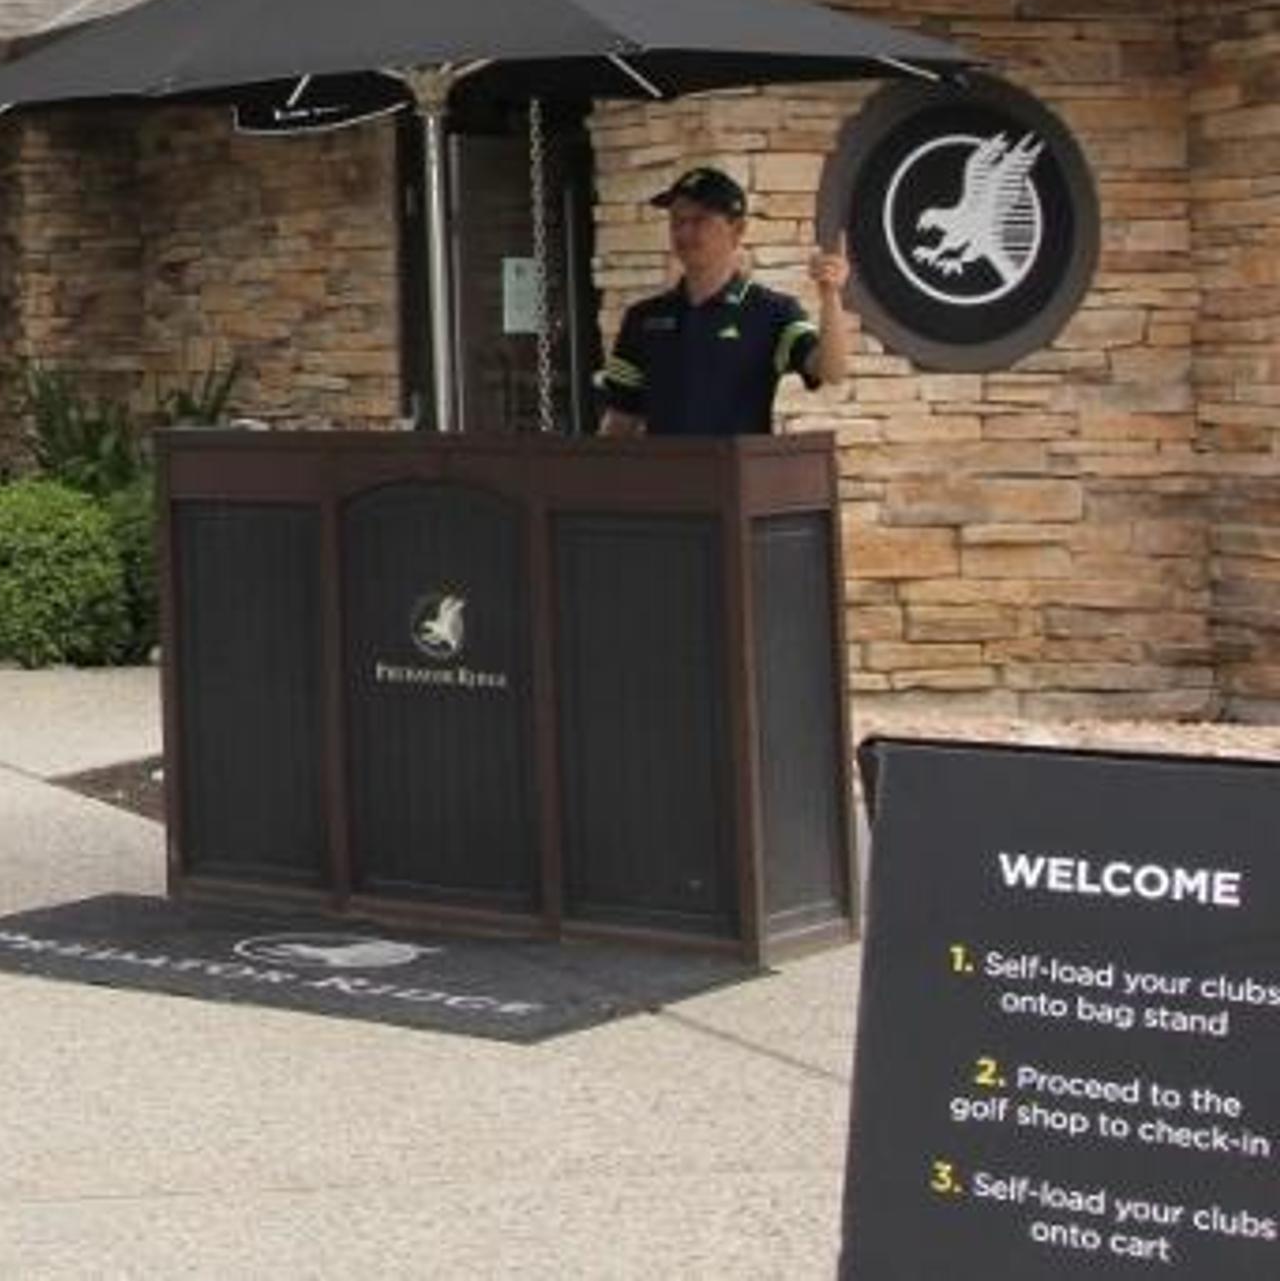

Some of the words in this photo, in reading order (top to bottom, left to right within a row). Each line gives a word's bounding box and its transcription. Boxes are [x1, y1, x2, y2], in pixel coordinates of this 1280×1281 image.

[999, 852, 1242, 907] WELCOME
[949, 945, 974, 973] 1.
[984, 951, 1114, 989] Self-load
[1123, 968, 1192, 998] your
[1200, 973, 1280, 1007] clubs
[1001, 990, 1069, 1018] onto
[1076, 996, 1135, 1030] bag
[1143, 1006, 1230, 1037] stand
[975, 1057, 1007, 1088] 2.
[1016, 1066, 1140, 1104] Proceed
[1149, 1081, 1182, 1108] to
[1190, 1087, 1242, 1118] the
[950, 1094, 1009, 1123] golf
[1016, 1103, 1091, 1137] shop
[1099, 1112, 1130, 1139] to
[1138, 1118, 1272, 1158] check-in
[930, 1161, 964, 1194] 3.
[973, 1171, 1106, 1217] Self-load
[1114, 1195, 1184, 1226] your
[1192, 1206, 1279, 1241] clubs
[1031, 1222, 1101, 1252] onto
[1110, 1231, 1172, 1263] cart
